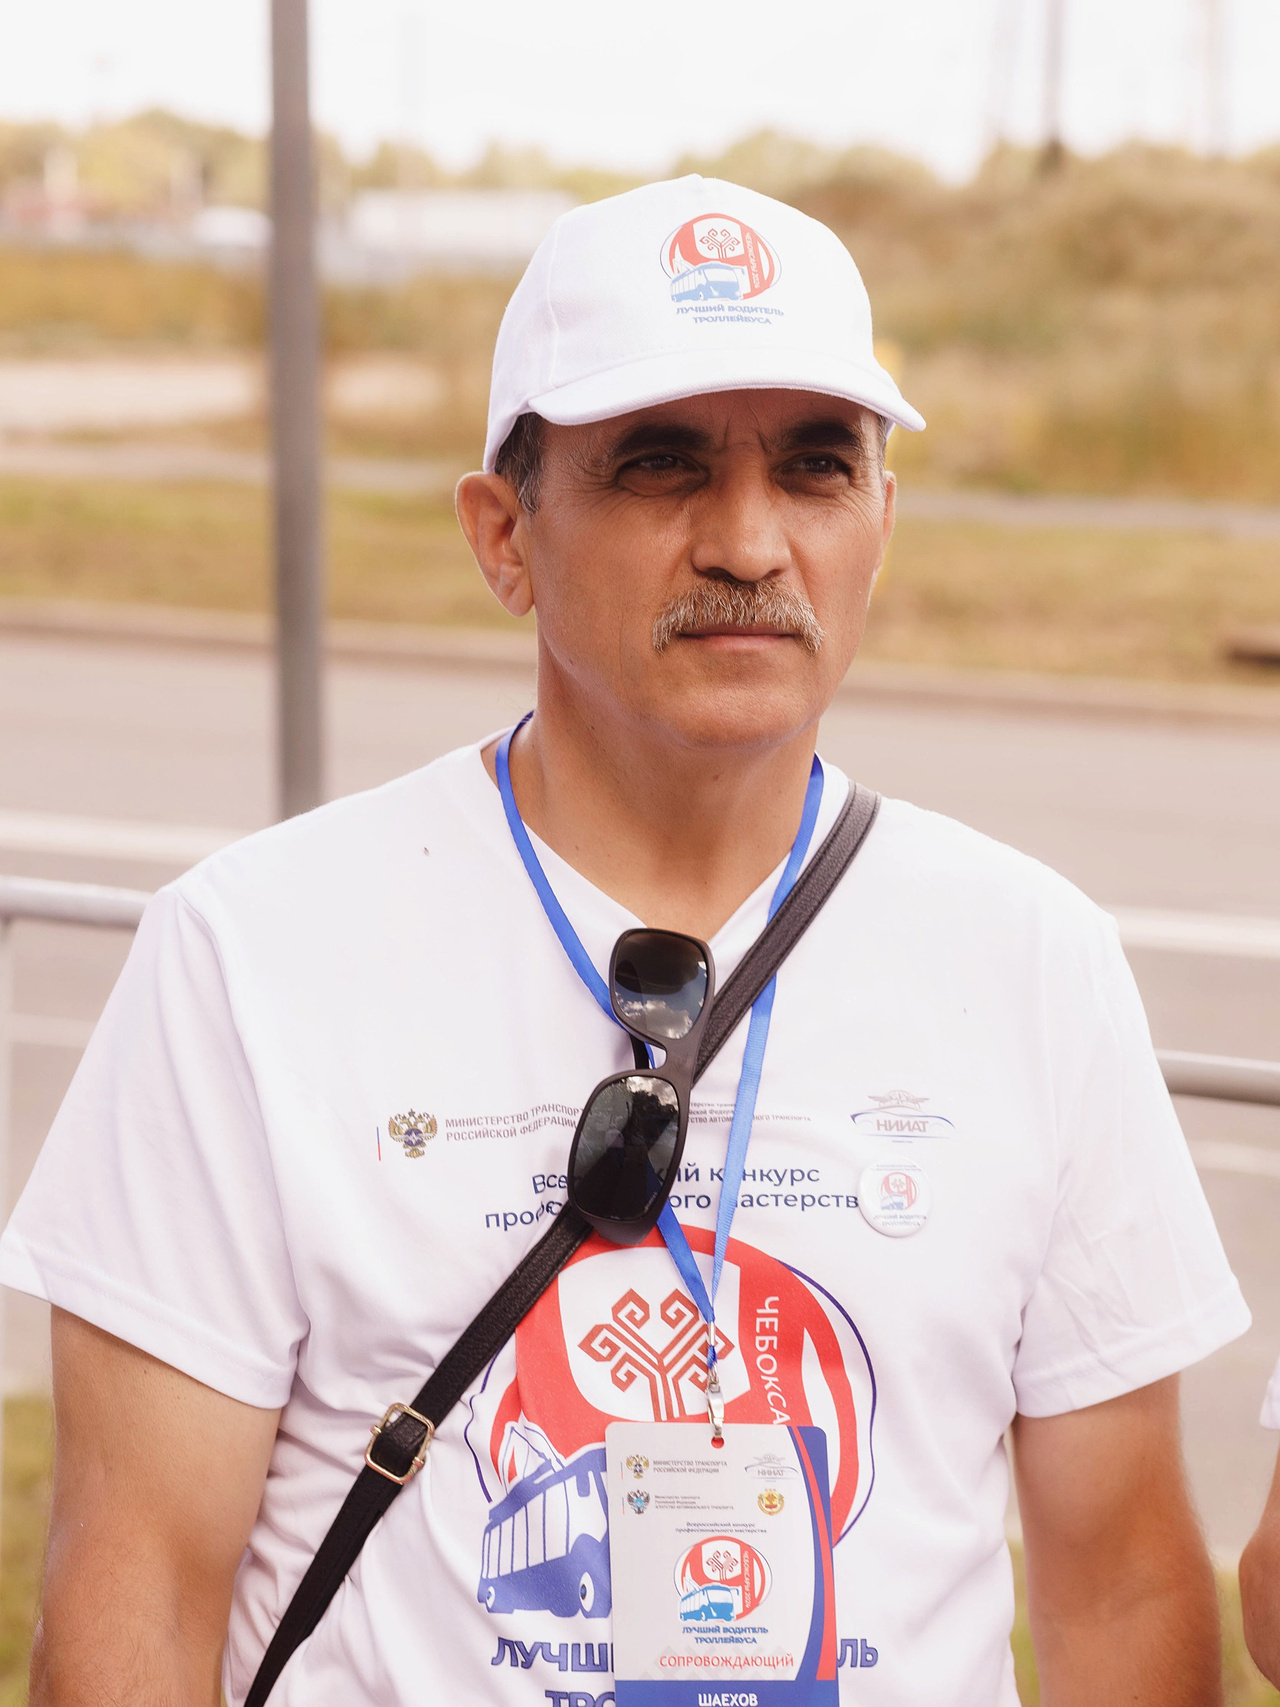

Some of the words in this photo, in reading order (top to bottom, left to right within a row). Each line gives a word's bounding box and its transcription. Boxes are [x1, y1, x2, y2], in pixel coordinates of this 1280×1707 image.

[676, 304, 725, 315] ЛУЧШИЙ
[728, 304, 784, 317] ВОДИТЕЛЬ
[692, 315, 772, 325] ТРОЛЛЕЙБУСА
[445, 1111, 529, 1129] МИНИСТЕРСТВО
[876, 1119, 929, 1133] НИИАТ
[446, 1127, 517, 1141] РОССИЙСКОЙ
[710, 1167, 820, 1187] кнкурс
[735, 1193, 859, 1212] астерств
[754, 1295, 792, 1426] ЧЕБОКСА
[722, 1626, 768, 1634] ВОДИТЕЛЬ
[694, 1636, 757, 1644] ТРОЛЛЕЙБУСА
[490, 1636, 614, 1673] ЛУЧШ
[659, 1653, 795, 1670] СОПРОВОЖДАЮЩИЙ
[698, 1693, 759, 1707] ШАЕХОВ
